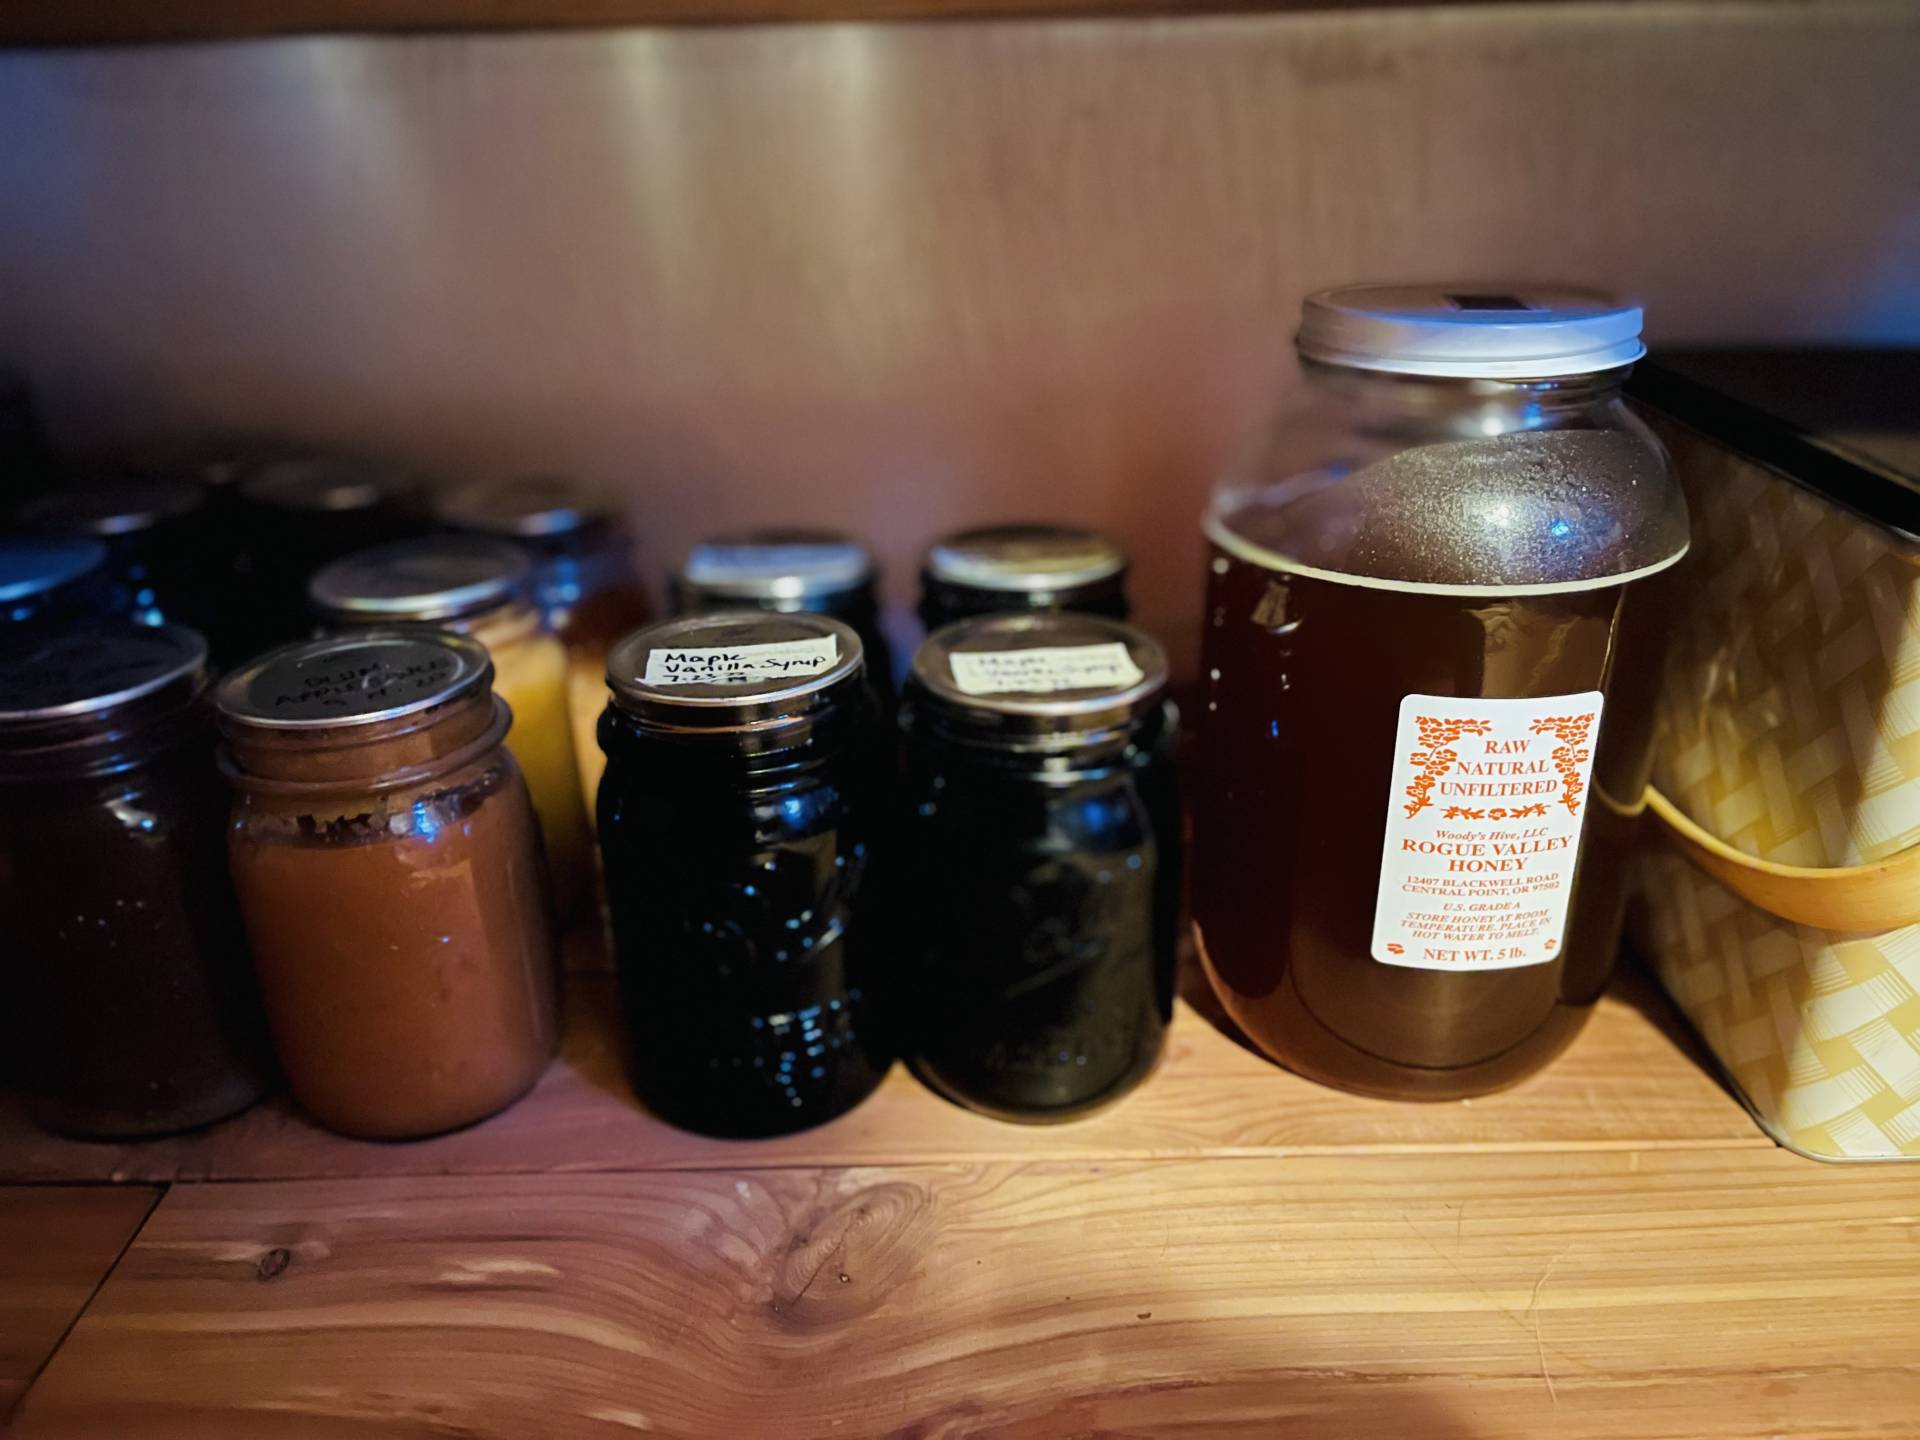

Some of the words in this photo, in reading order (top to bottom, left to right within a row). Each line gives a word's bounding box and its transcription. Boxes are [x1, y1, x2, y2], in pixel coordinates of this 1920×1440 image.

[666, 662, 754, 673] Vanilla
[760, 656, 826, 670] Syrup
[1484, 739, 1530, 754] RAW
[1456, 760, 1550, 776] NATURAL
[1440, 779, 1558, 796] UNFILTERED
[1436, 830, 1486, 842] Woody's
[1488, 829, 1520, 840] Hive,
[1522, 827, 1549, 838] LLC
[1402, 838, 1486, 856] ROGUE
[1493, 836, 1573, 856] VALLEY
[1448, 857, 1528, 873] HONEY
[1406, 876, 1440, 886] 12407
[1442, 877, 1524, 888] BLACKWELL
[1526, 872, 1559, 884] ROAD
[1402, 884, 1466, 896] CENTRAL
[1468, 886, 1510, 896] POINT,
[1512, 884, 1530, 894] OR
[1532, 881, 1560, 891] 97502
[1443, 902, 1466, 912] U.S.
[1468, 902, 1510, 912] GRADE
[1511, 902, 1521, 910] A
[1406, 912, 1450, 922] STORE
[1452, 914, 1497, 924] HONEY
[1496, 913, 1513, 922] AT
[1514, 909, 1550, 921] ROOM
[1499, 920, 1537, 931] PLACE
[1538, 917, 1552, 926] IN
[1412, 930, 1440, 940] HOT
[1443, 931, 1486, 942] WATER
[1487, 932, 1504, 940] TO
[1424, 948, 1462, 962] NET
[1464, 949, 1494, 962] WT.
[1497, 948, 1506, 960] 5
[1508, 947, 1526, 959] lb.
